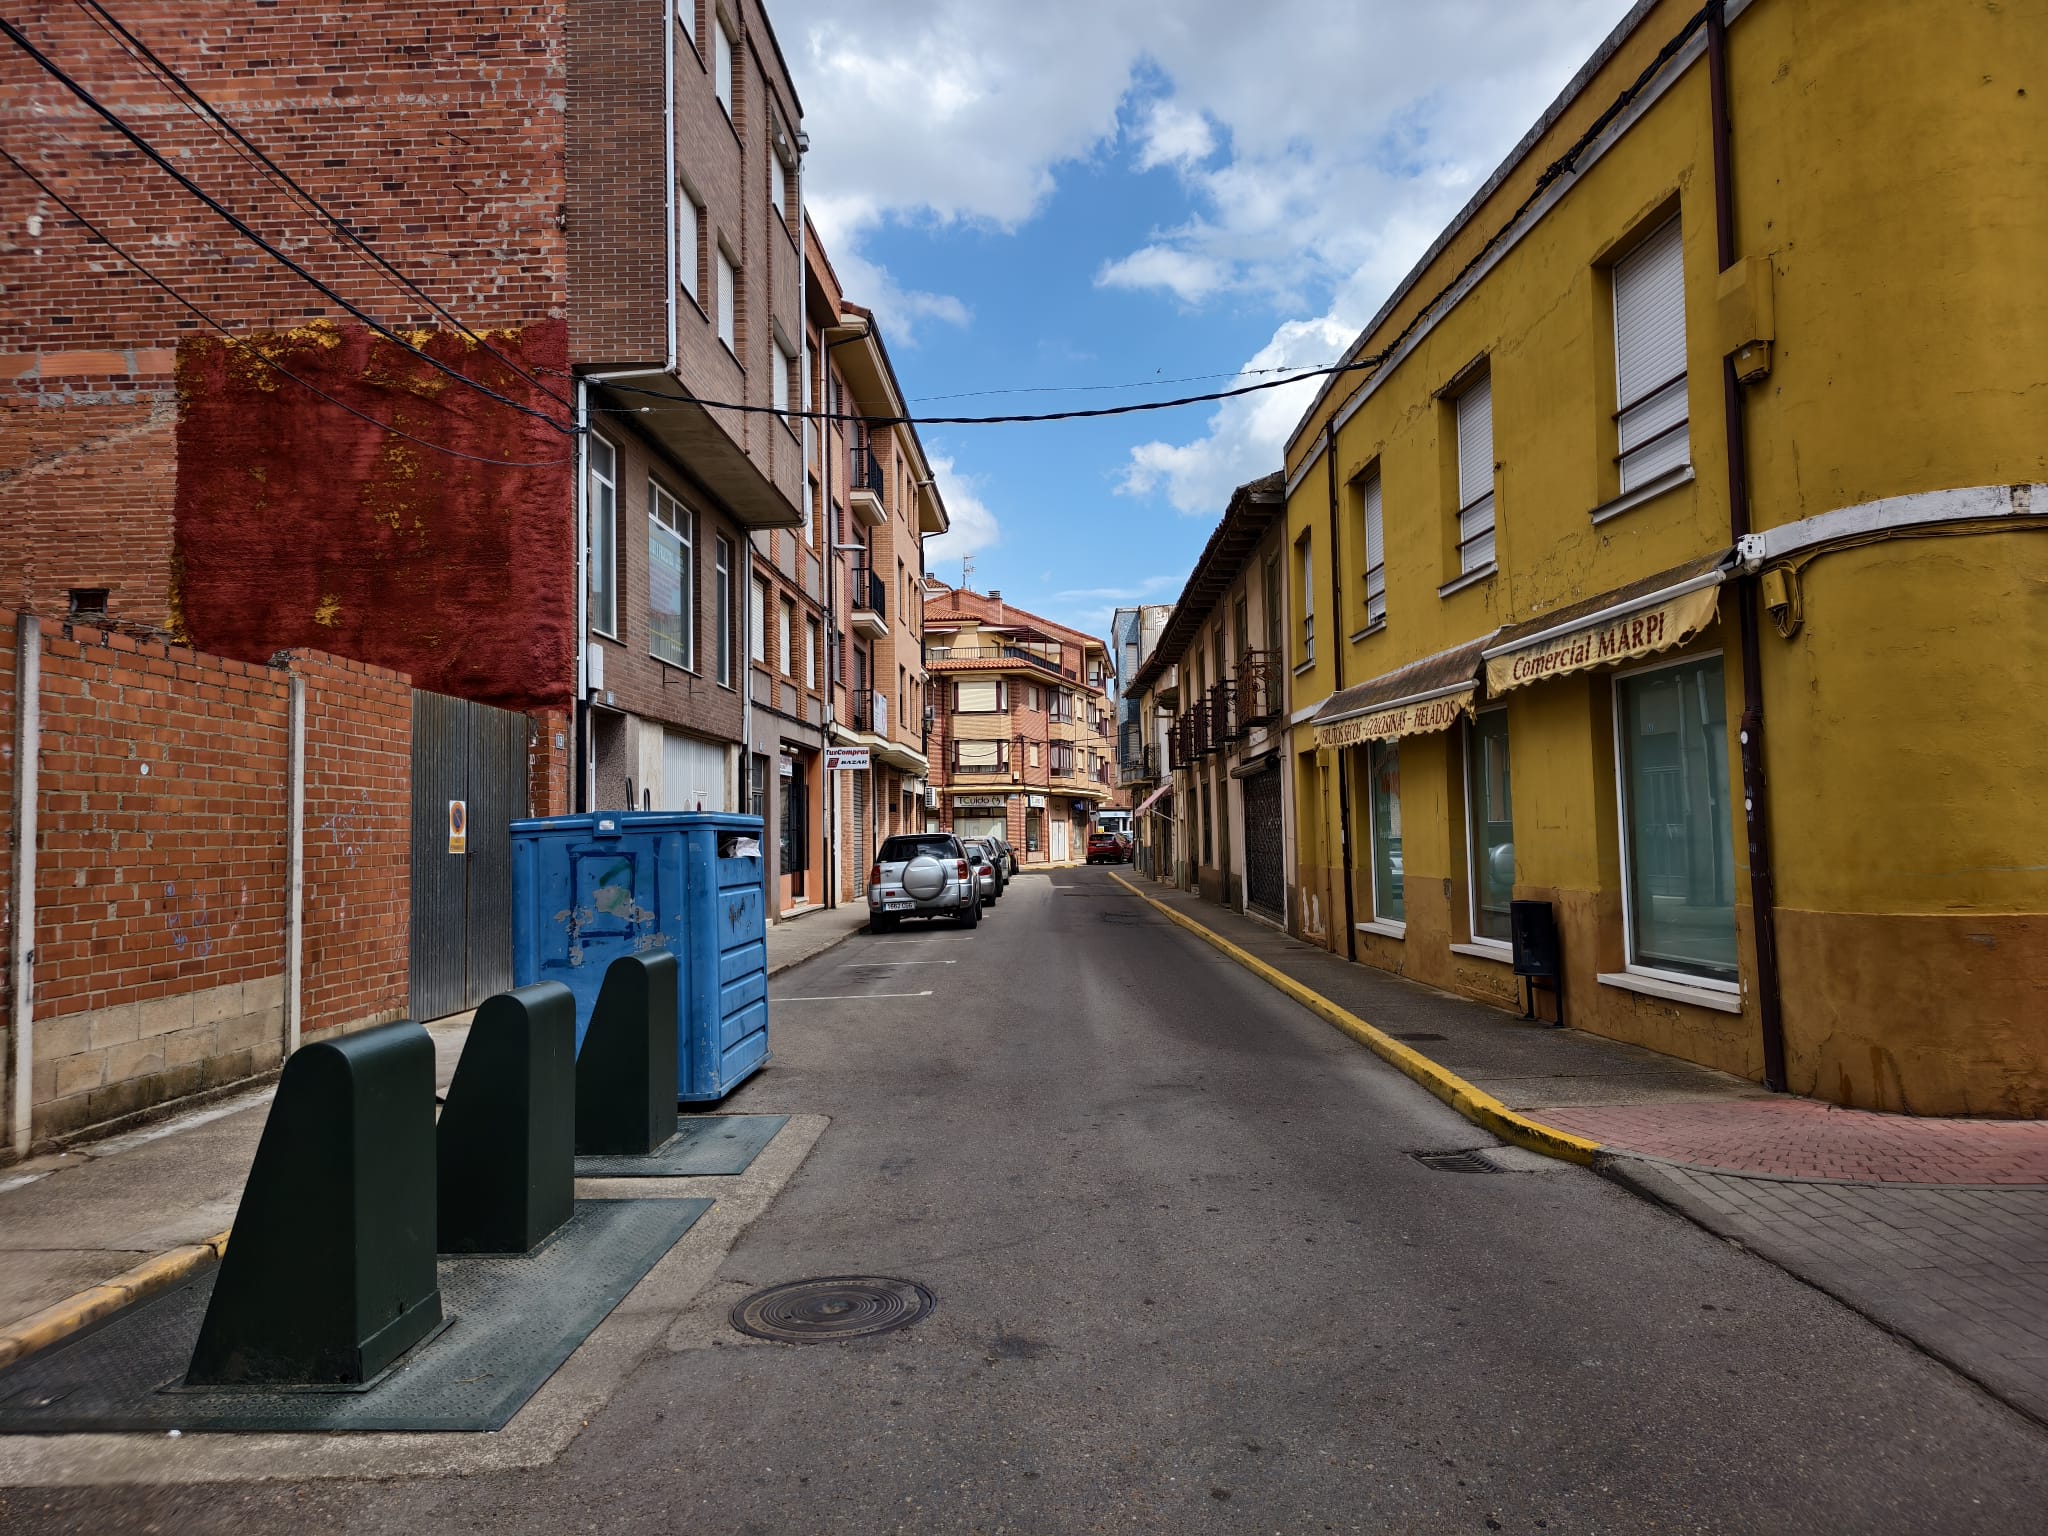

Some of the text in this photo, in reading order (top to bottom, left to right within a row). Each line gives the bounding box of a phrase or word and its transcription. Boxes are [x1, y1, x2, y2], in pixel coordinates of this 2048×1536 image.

[1513, 611, 1665, 681] Comercial MARPI
[1321, 726, 1344, 745] FRUTOS
[1344, 721, 1362, 742] SECOS
[1365, 710, 1408, 737] GOLOSINAS
[1413, 700, 1456, 728] HELADOS
